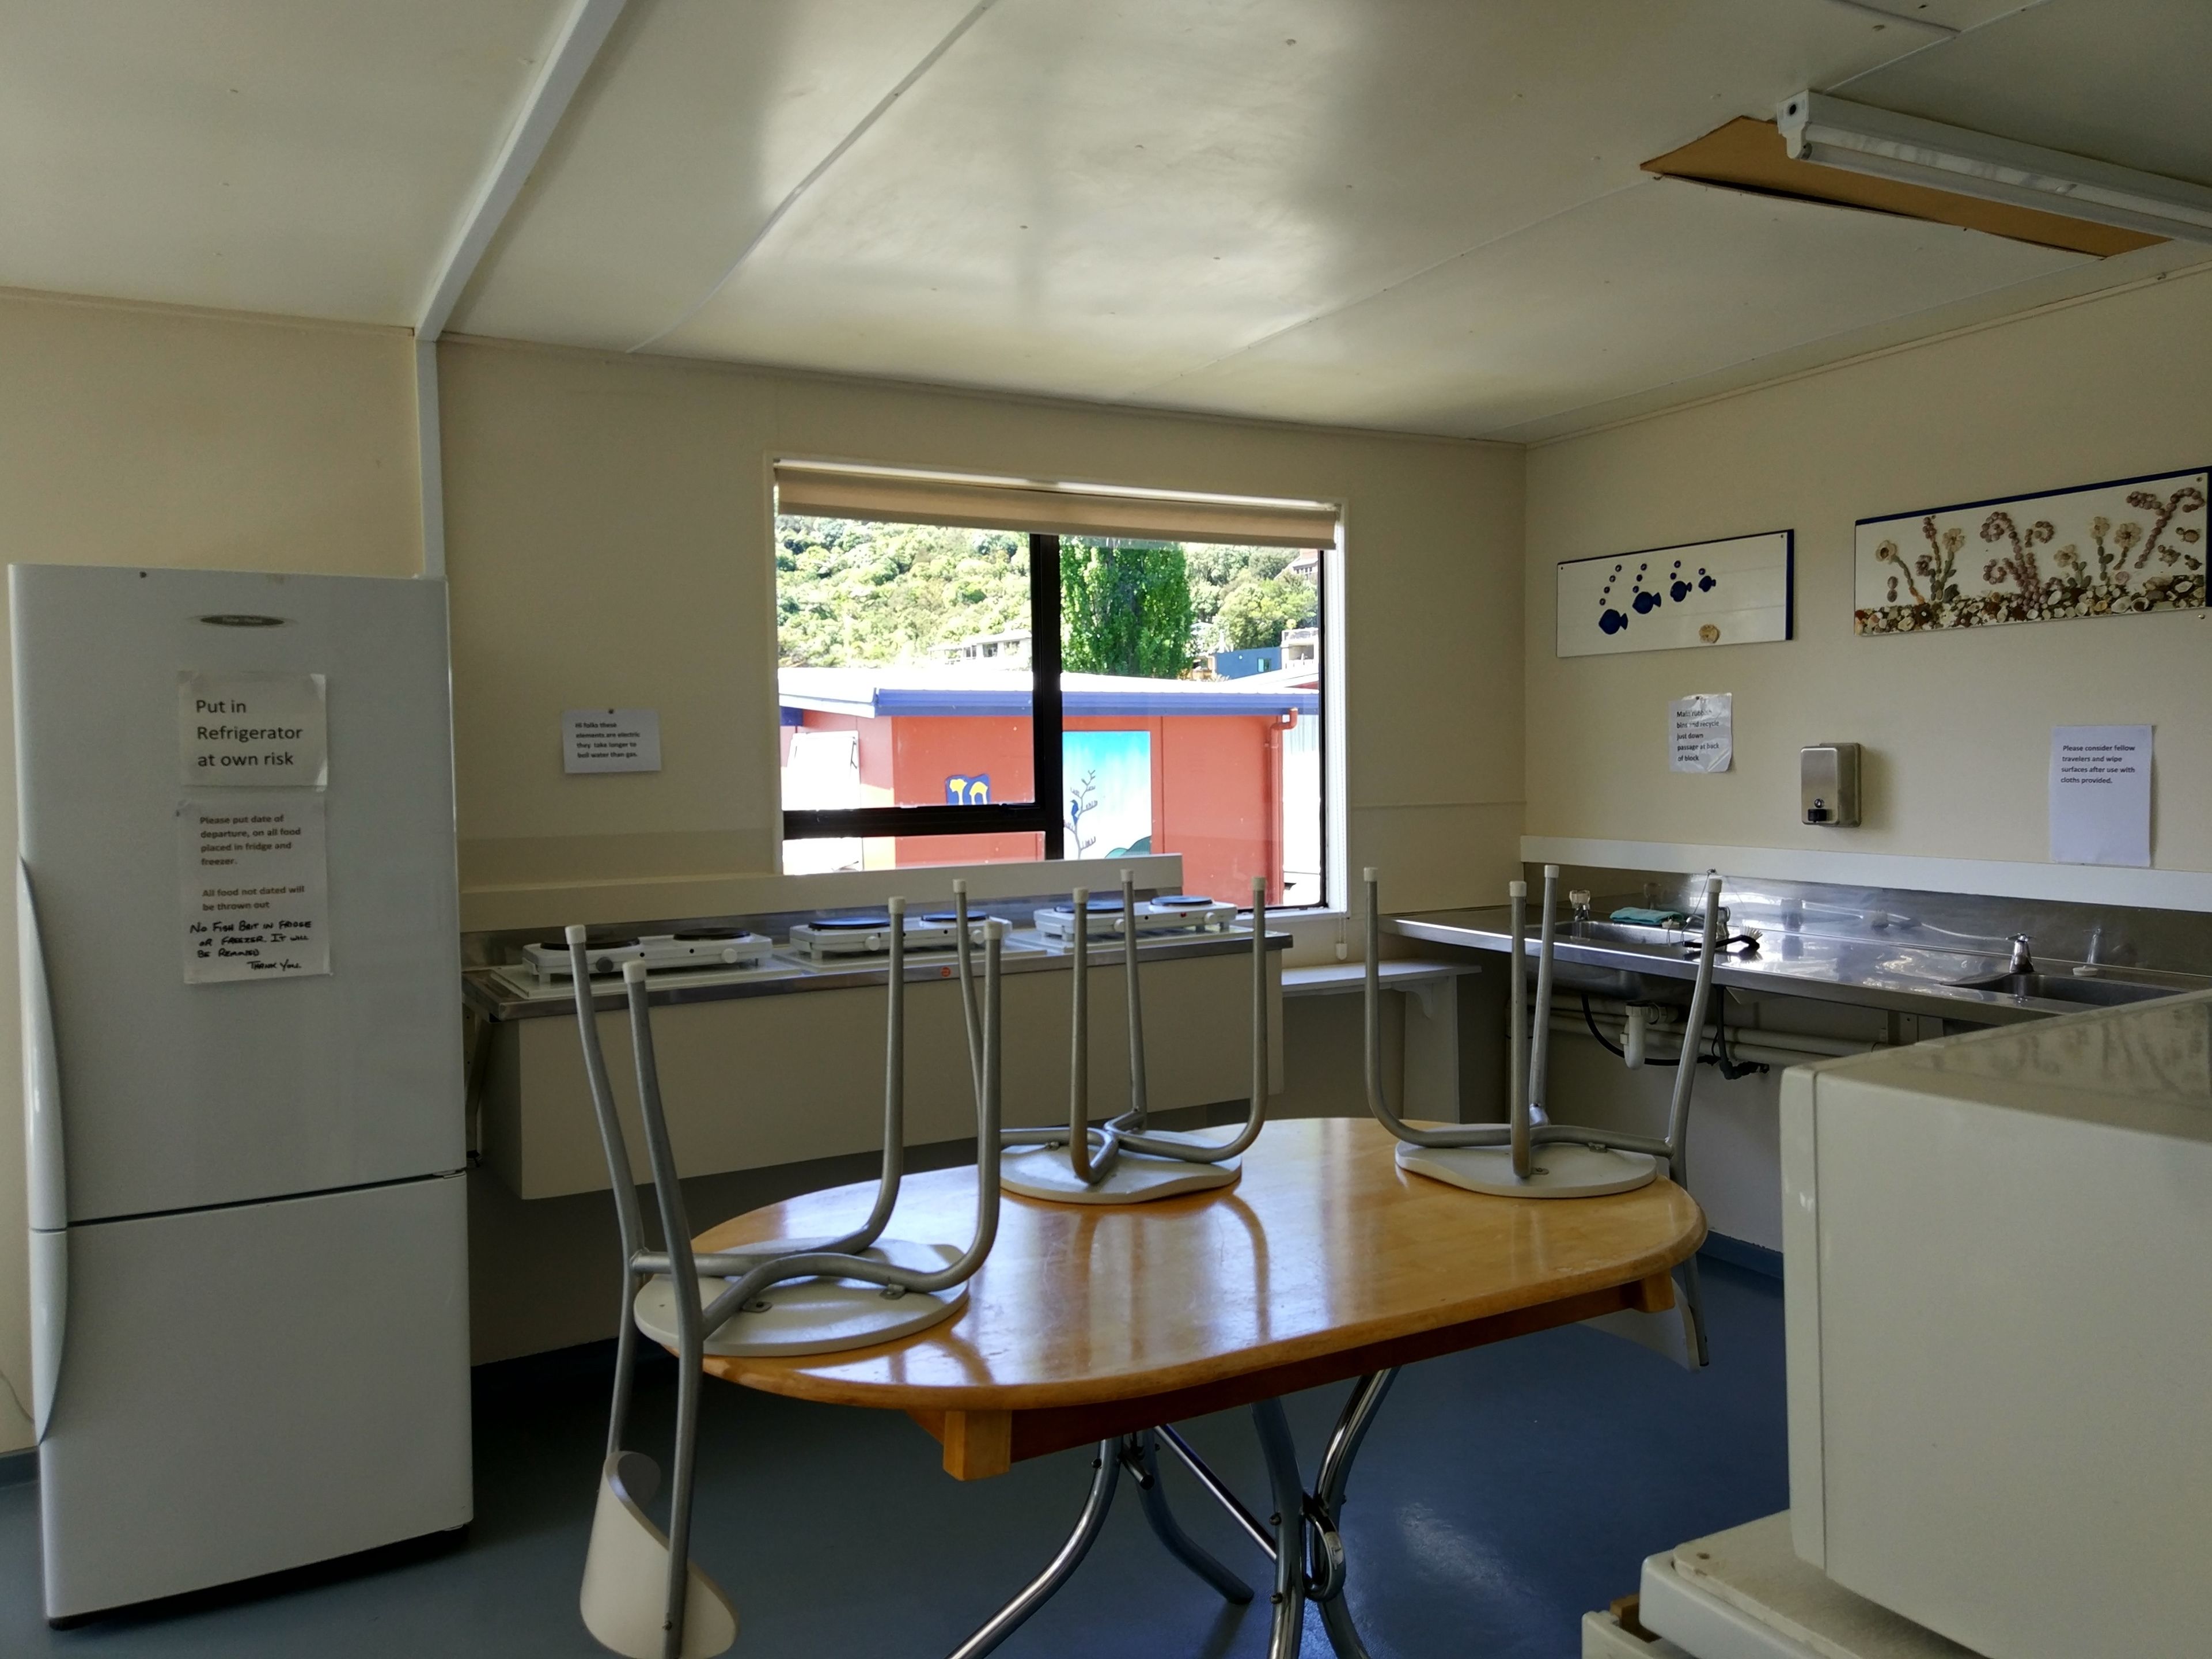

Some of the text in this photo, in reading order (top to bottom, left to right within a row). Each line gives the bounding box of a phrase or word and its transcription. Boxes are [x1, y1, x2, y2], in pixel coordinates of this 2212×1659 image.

[196, 699, 246, 713] Put in
[197, 725, 303, 743] Refrigerator
[1677, 733, 1687, 741] just
[198, 752, 294, 767] at own risk
[200, 815, 285, 825] Please put date of
[200, 831, 250, 839] departure,
[280, 828, 301, 836] food
[200, 844, 232, 853] placed
[245, 843, 272, 851] fridge
[274, 842, 291, 850] and
[201, 858, 238, 866] freezer.
[217, 888, 239, 896] food
[288, 885, 305, 893] will
[202, 903, 214, 911] be
[217, 903, 251, 911] thrown
